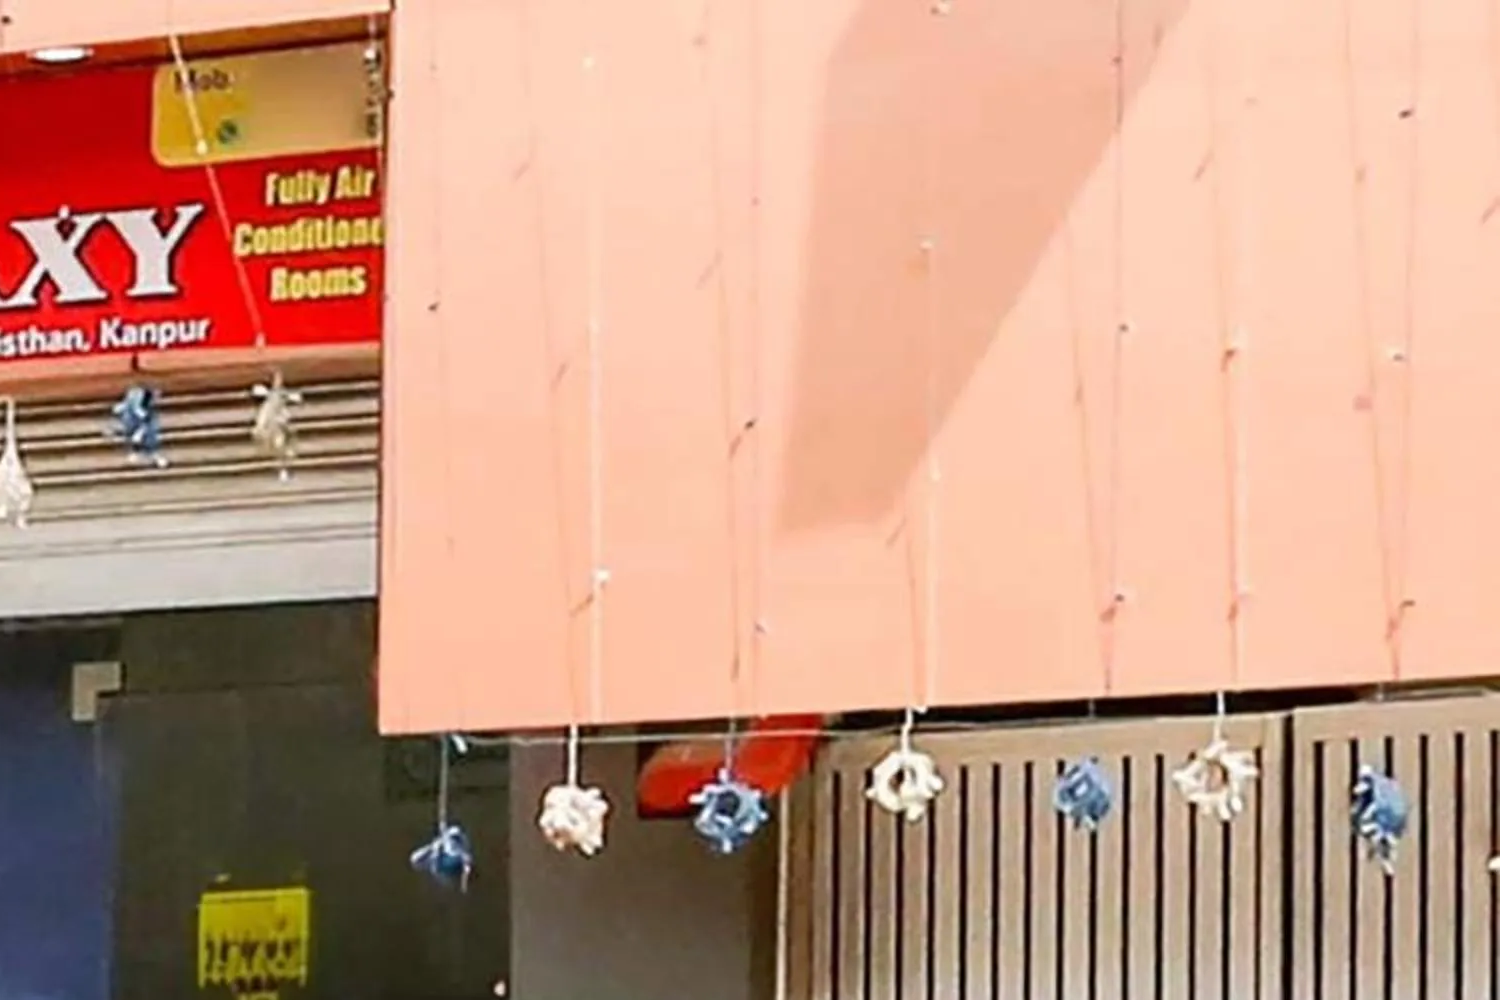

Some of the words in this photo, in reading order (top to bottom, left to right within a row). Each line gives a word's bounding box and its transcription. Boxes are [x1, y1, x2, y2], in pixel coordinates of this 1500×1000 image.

[266, 170, 330, 206] Fully
[335, 165, 375, 199] Air
[270, 265, 367, 301] Rooms
[100, 317, 212, 350] Kanpur
